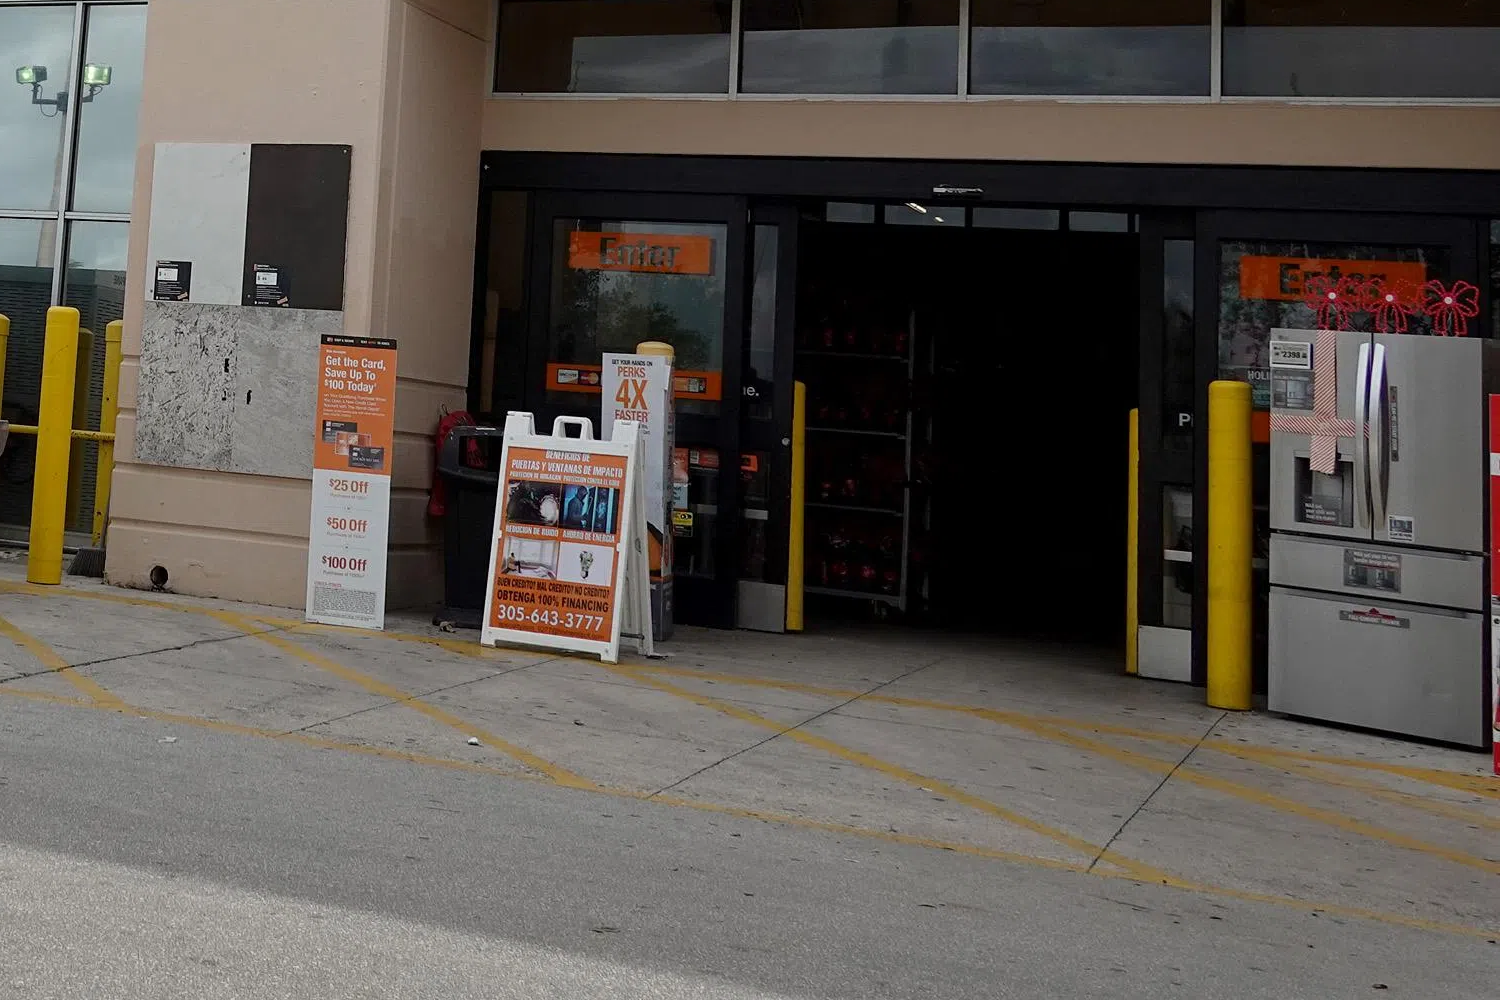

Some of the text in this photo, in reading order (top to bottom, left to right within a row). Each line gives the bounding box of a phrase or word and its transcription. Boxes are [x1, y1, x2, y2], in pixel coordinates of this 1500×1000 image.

[600, 237, 681, 267] Enter
[325, 355, 386, 371] Get the Card,
[324, 368, 376, 381] Save Up To
[617, 366, 646, 378] PERKS
[324, 379, 344, 390] $100
[615, 378, 649, 411] 4X
[614, 409, 649, 423] FASTER
[545, 450, 591, 462] BENEFICIOS DE
[511, 459, 623, 479] PUERTAS Y VENTANAS DE IMPACTO
[329, 478, 369, 494] $25 Off
[326, 516, 368, 533] $50 Off
[533, 527, 541, 536] DE
[585, 531, 591, 541] DE
[322, 555, 367, 572] $100 Off
[497, 576, 610, 599] BUEN CREDITO? MAL CREDITO? NO CREDITO?
[497, 589, 609, 613] OBTENGA 100% FINANCING
[498, 604, 604, 632] 305-643-3777
